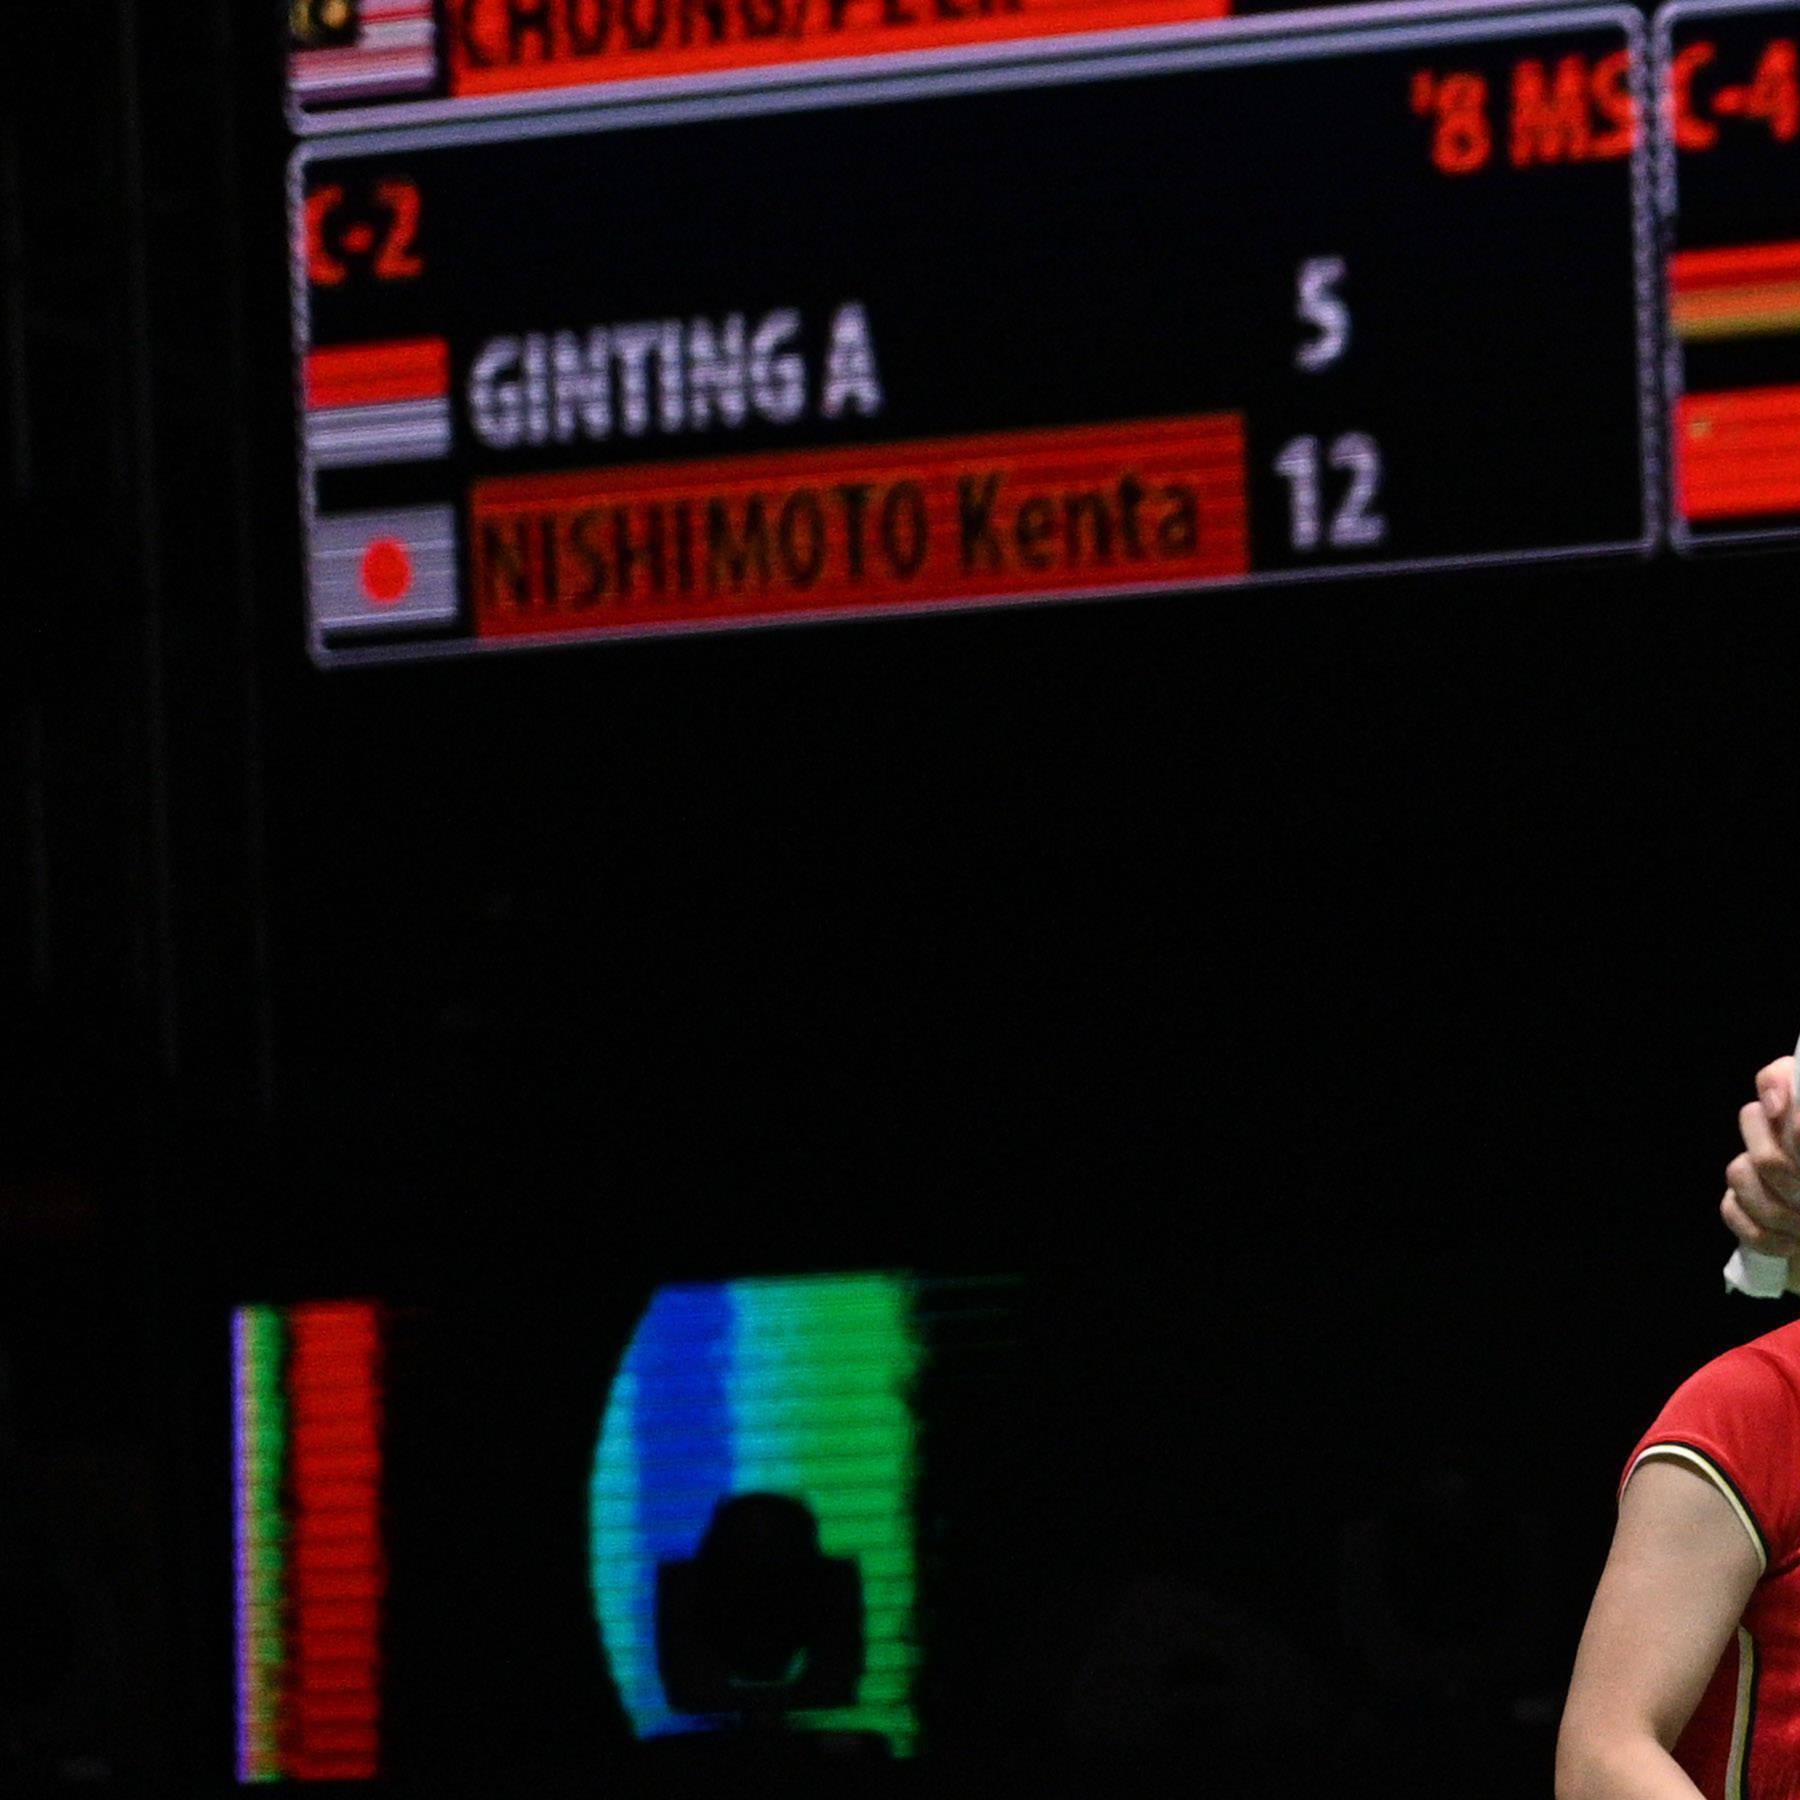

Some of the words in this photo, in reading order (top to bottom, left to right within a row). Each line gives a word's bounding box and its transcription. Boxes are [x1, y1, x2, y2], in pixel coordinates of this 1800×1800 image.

[469, 307, 806, 449] GINTING
[820, 300, 885, 419] A
[1295, 255, 1352, 374] 5
[478, 478, 931, 612] NISHIMOTO
[953, 466, 1201, 577] Kenta
[1274, 431, 1389, 552] 12
